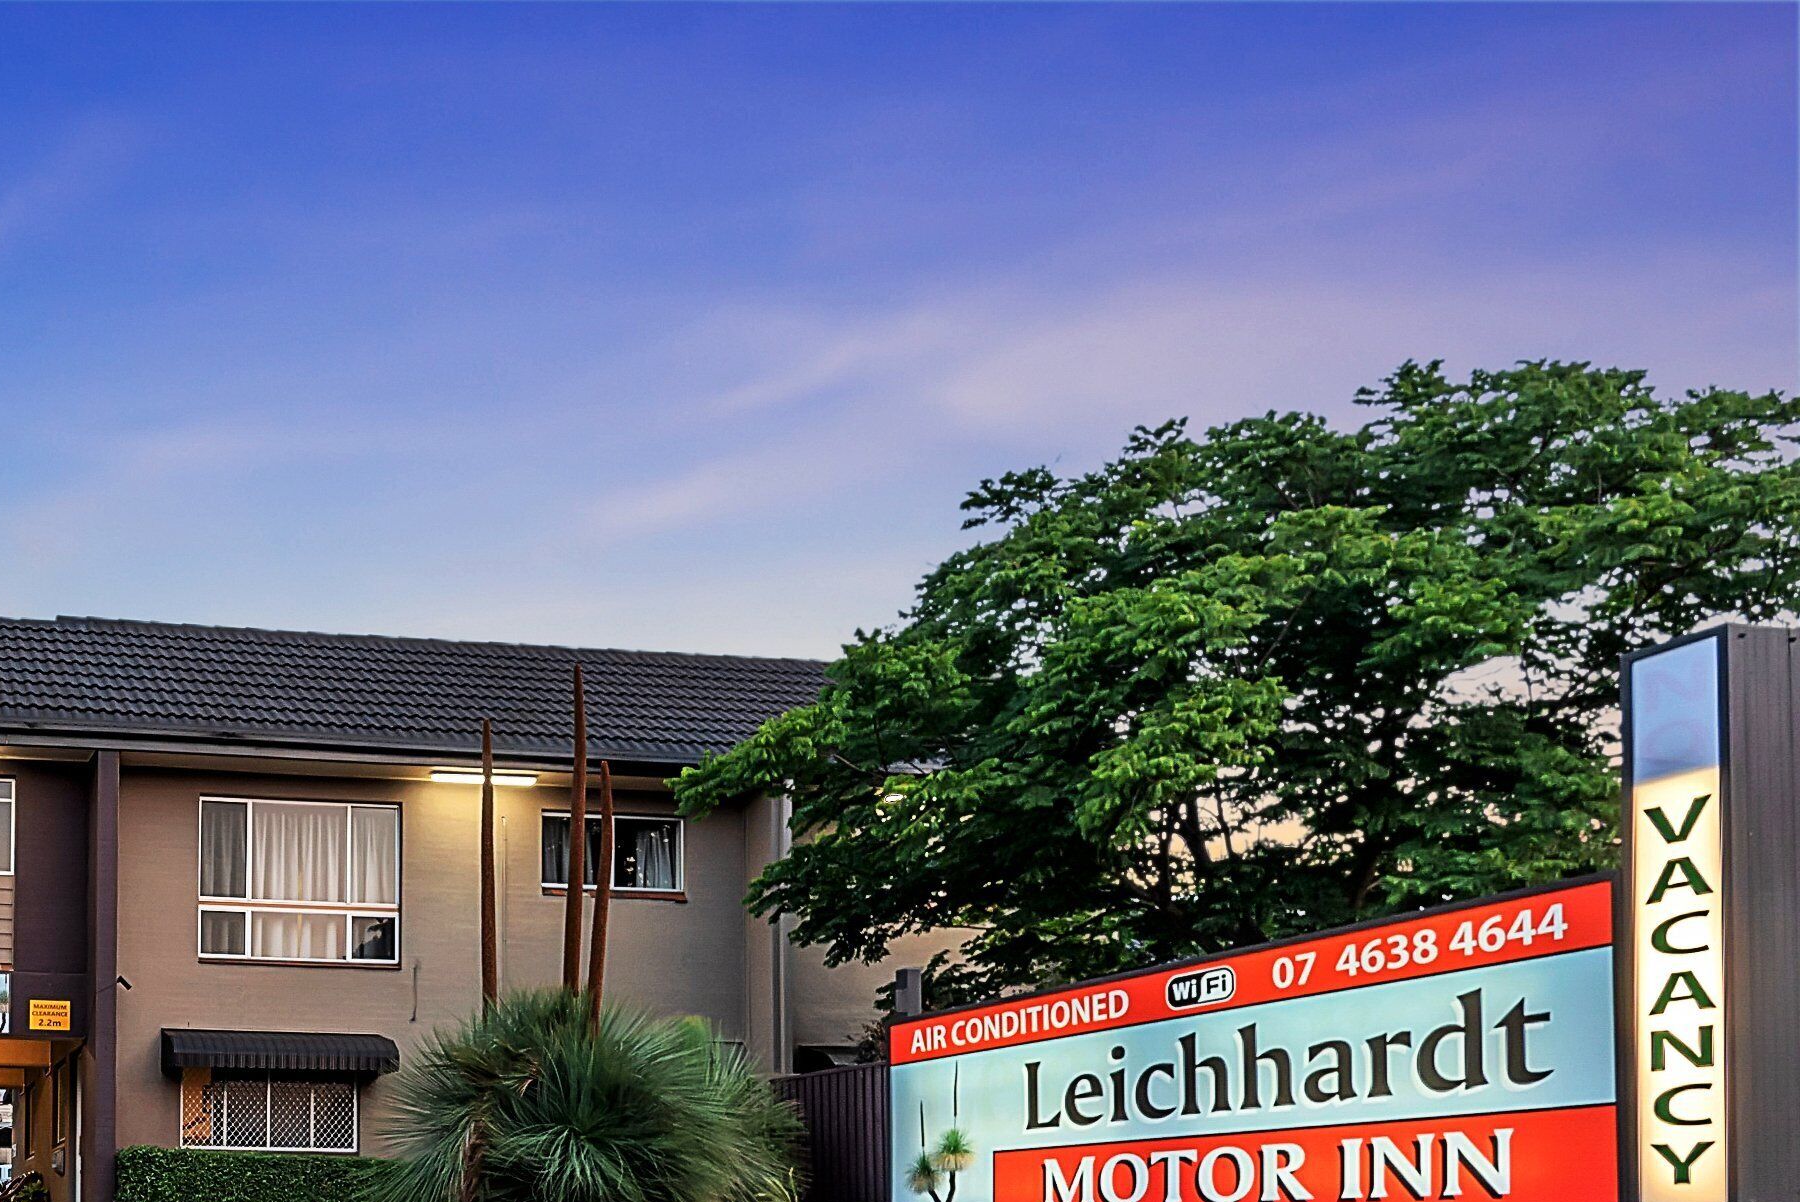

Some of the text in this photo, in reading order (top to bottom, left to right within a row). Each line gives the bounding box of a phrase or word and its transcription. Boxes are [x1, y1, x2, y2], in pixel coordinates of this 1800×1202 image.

[38, 1018, 62, 1027] 2.2m
[911, 1025, 947, 1054] AIR
[951, 989, 1130, 1047] CONDITIONED
[1272, 952, 1317, 989] 07
[1335, 929, 1439, 977] 4638
[1449, 902, 1568, 957] 4644
[1644, 793, 1716, 1186] VACANCY
[1024, 987, 1555, 1131] Leichhardt
[1337, 1128, 1515, 1202] INN
